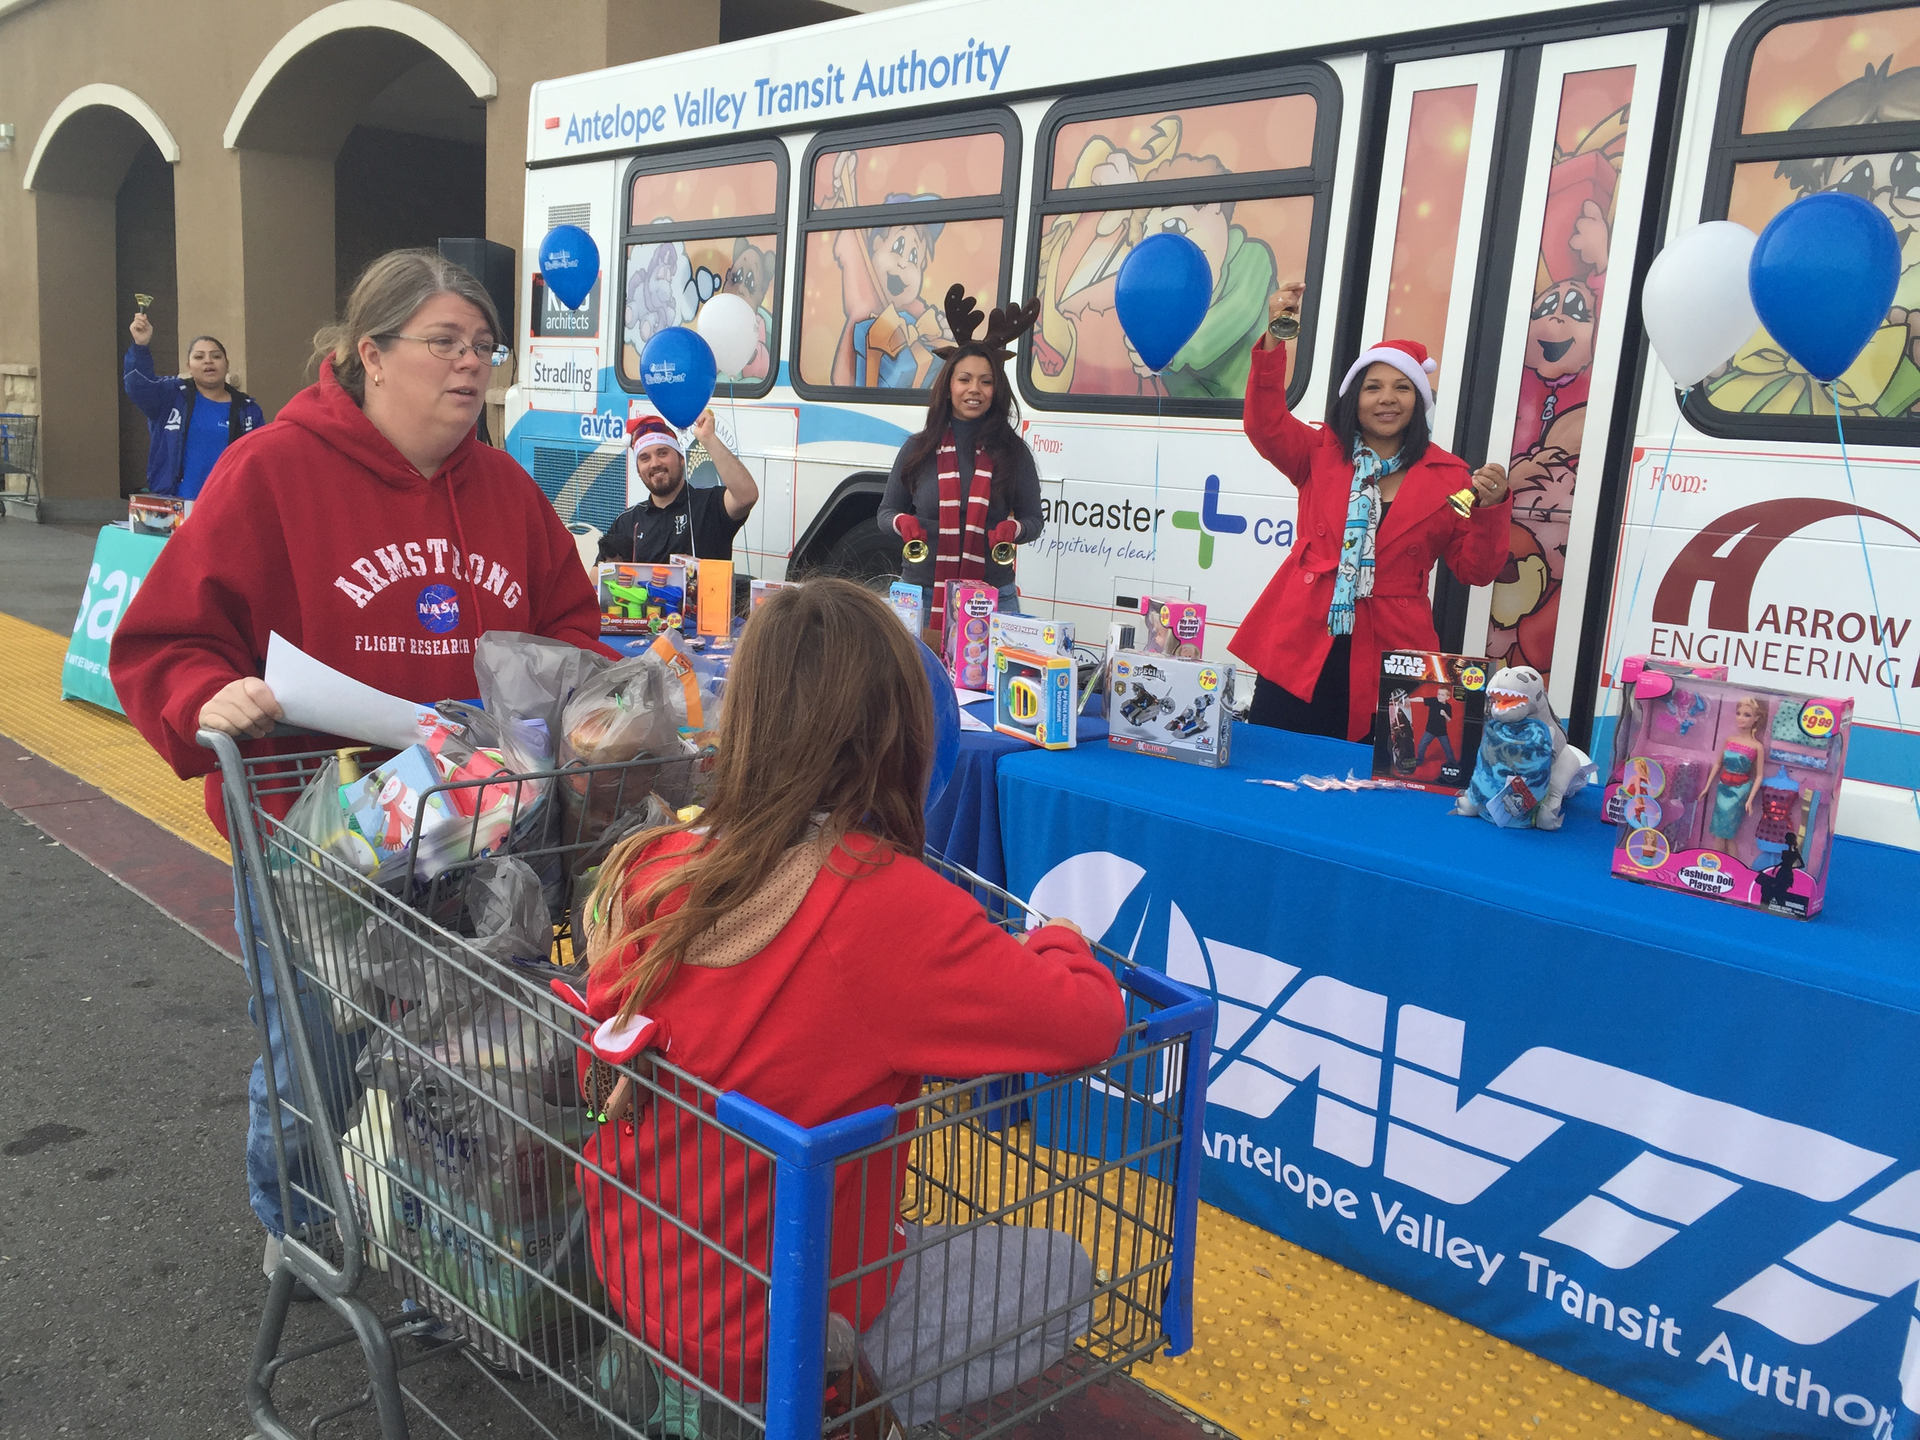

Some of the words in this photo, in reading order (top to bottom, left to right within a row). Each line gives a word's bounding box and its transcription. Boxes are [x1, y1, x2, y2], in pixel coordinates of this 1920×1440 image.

[564, 103, 666, 146] Antelope
[673, 87, 747, 130] Valley
[754, 63, 845, 117] Transit
[851, 37, 1011, 102] Authority
[545, 312, 590, 330] architects
[533, 361, 593, 392] Stradling
[581, 412, 623, 439] avta
[1032, 434, 1063, 453] From:
[1650, 467, 1708, 493] From:
[1040, 498, 1165, 533] ancaster
[1046, 536, 1112, 567] positively
[1117, 541, 1156, 562] clear.
[333, 538, 522, 609] ARMSTRONG
[419, 602, 459, 615] NASA
[1755, 603, 1912, 648] ARROW
[355, 635, 405, 652] FLIGHT
[410, 638, 470, 655] RESEARCH
[1650, 627, 1901, 689] ENGINEERING
[1384, 654, 1426, 667] STAR
[1384, 663, 1426, 677] WARS
[1132, 665, 1167, 683] SPECIAL
[1680, 867, 1714, 883] Fashion
[1716, 875, 1734, 887] Doll
[1688, 879, 1721, 894] Playset
[1371, 1191, 1505, 1287] Valley
[1519, 1251, 1682, 1358] Transit
